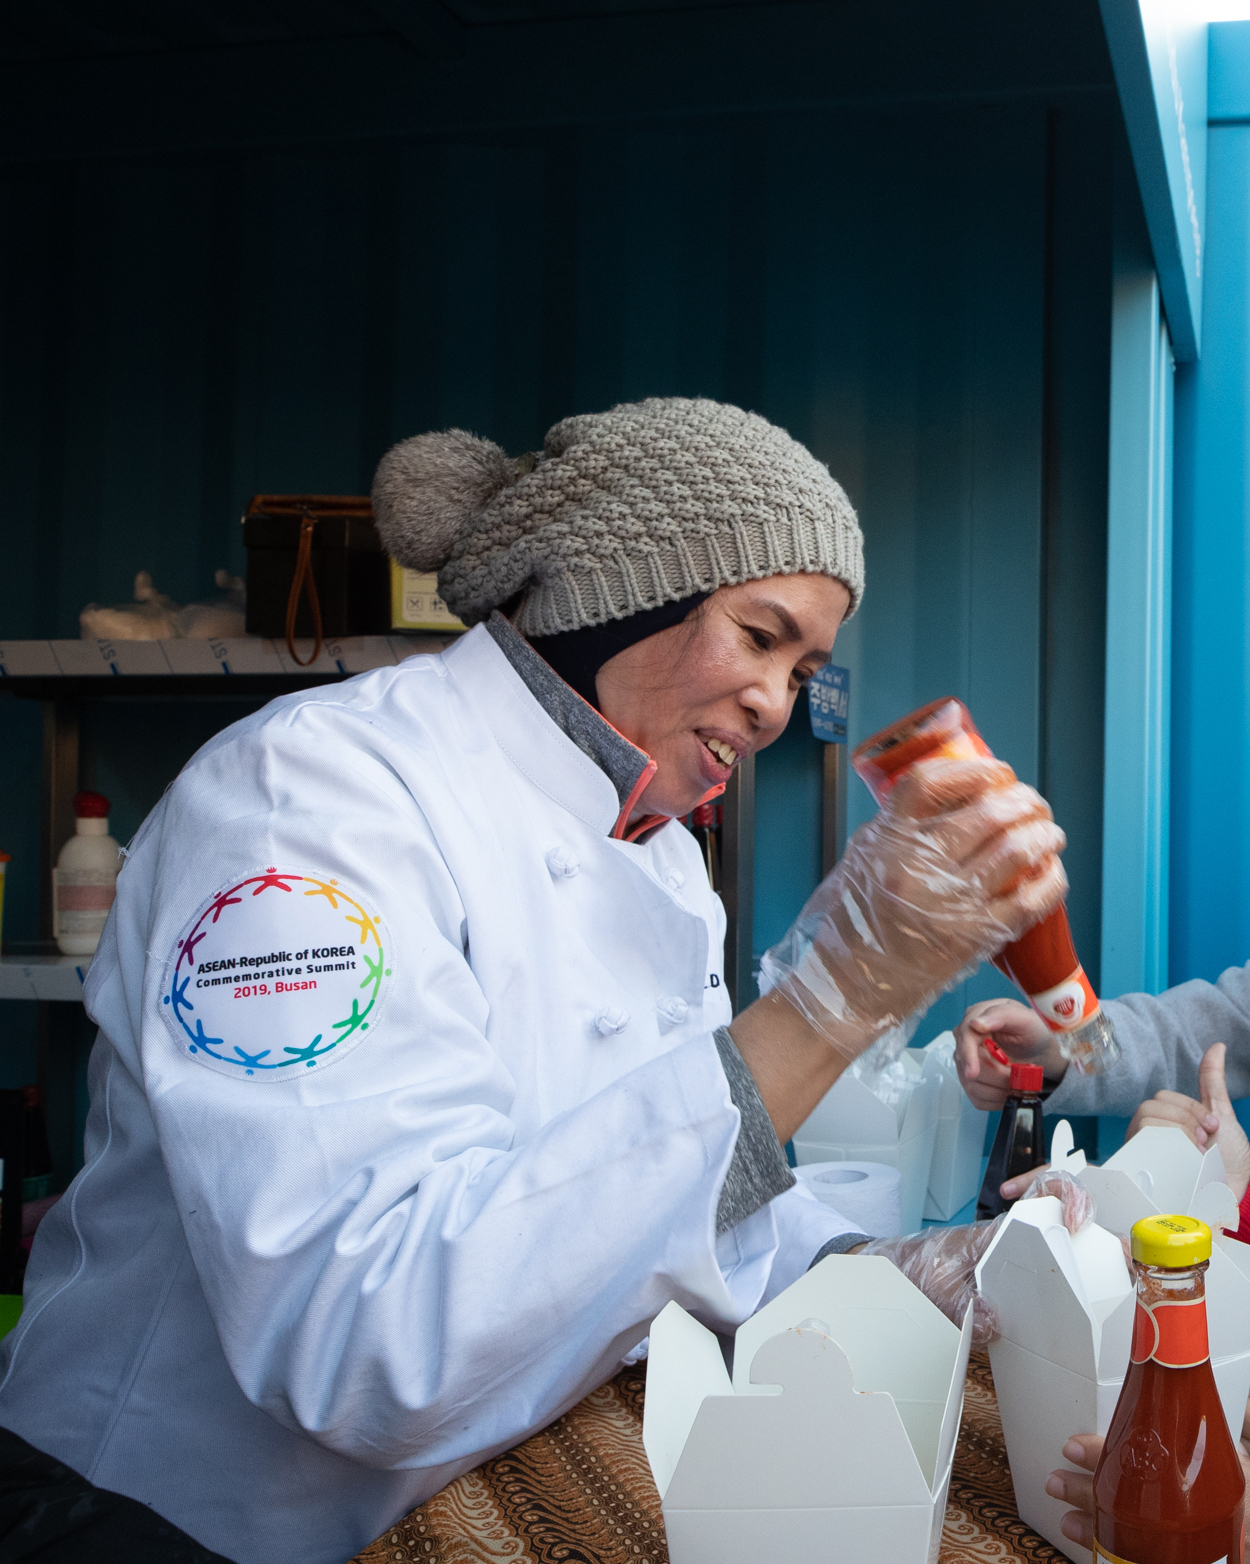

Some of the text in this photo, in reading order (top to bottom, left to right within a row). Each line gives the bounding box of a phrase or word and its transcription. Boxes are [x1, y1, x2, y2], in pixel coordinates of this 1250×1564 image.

[196, 960, 357, 988] Commemorative Summit
[197, 945, 356, 975] ASEAN-Republic of KOREA
[233, 980, 317, 999] 2019, Busan
